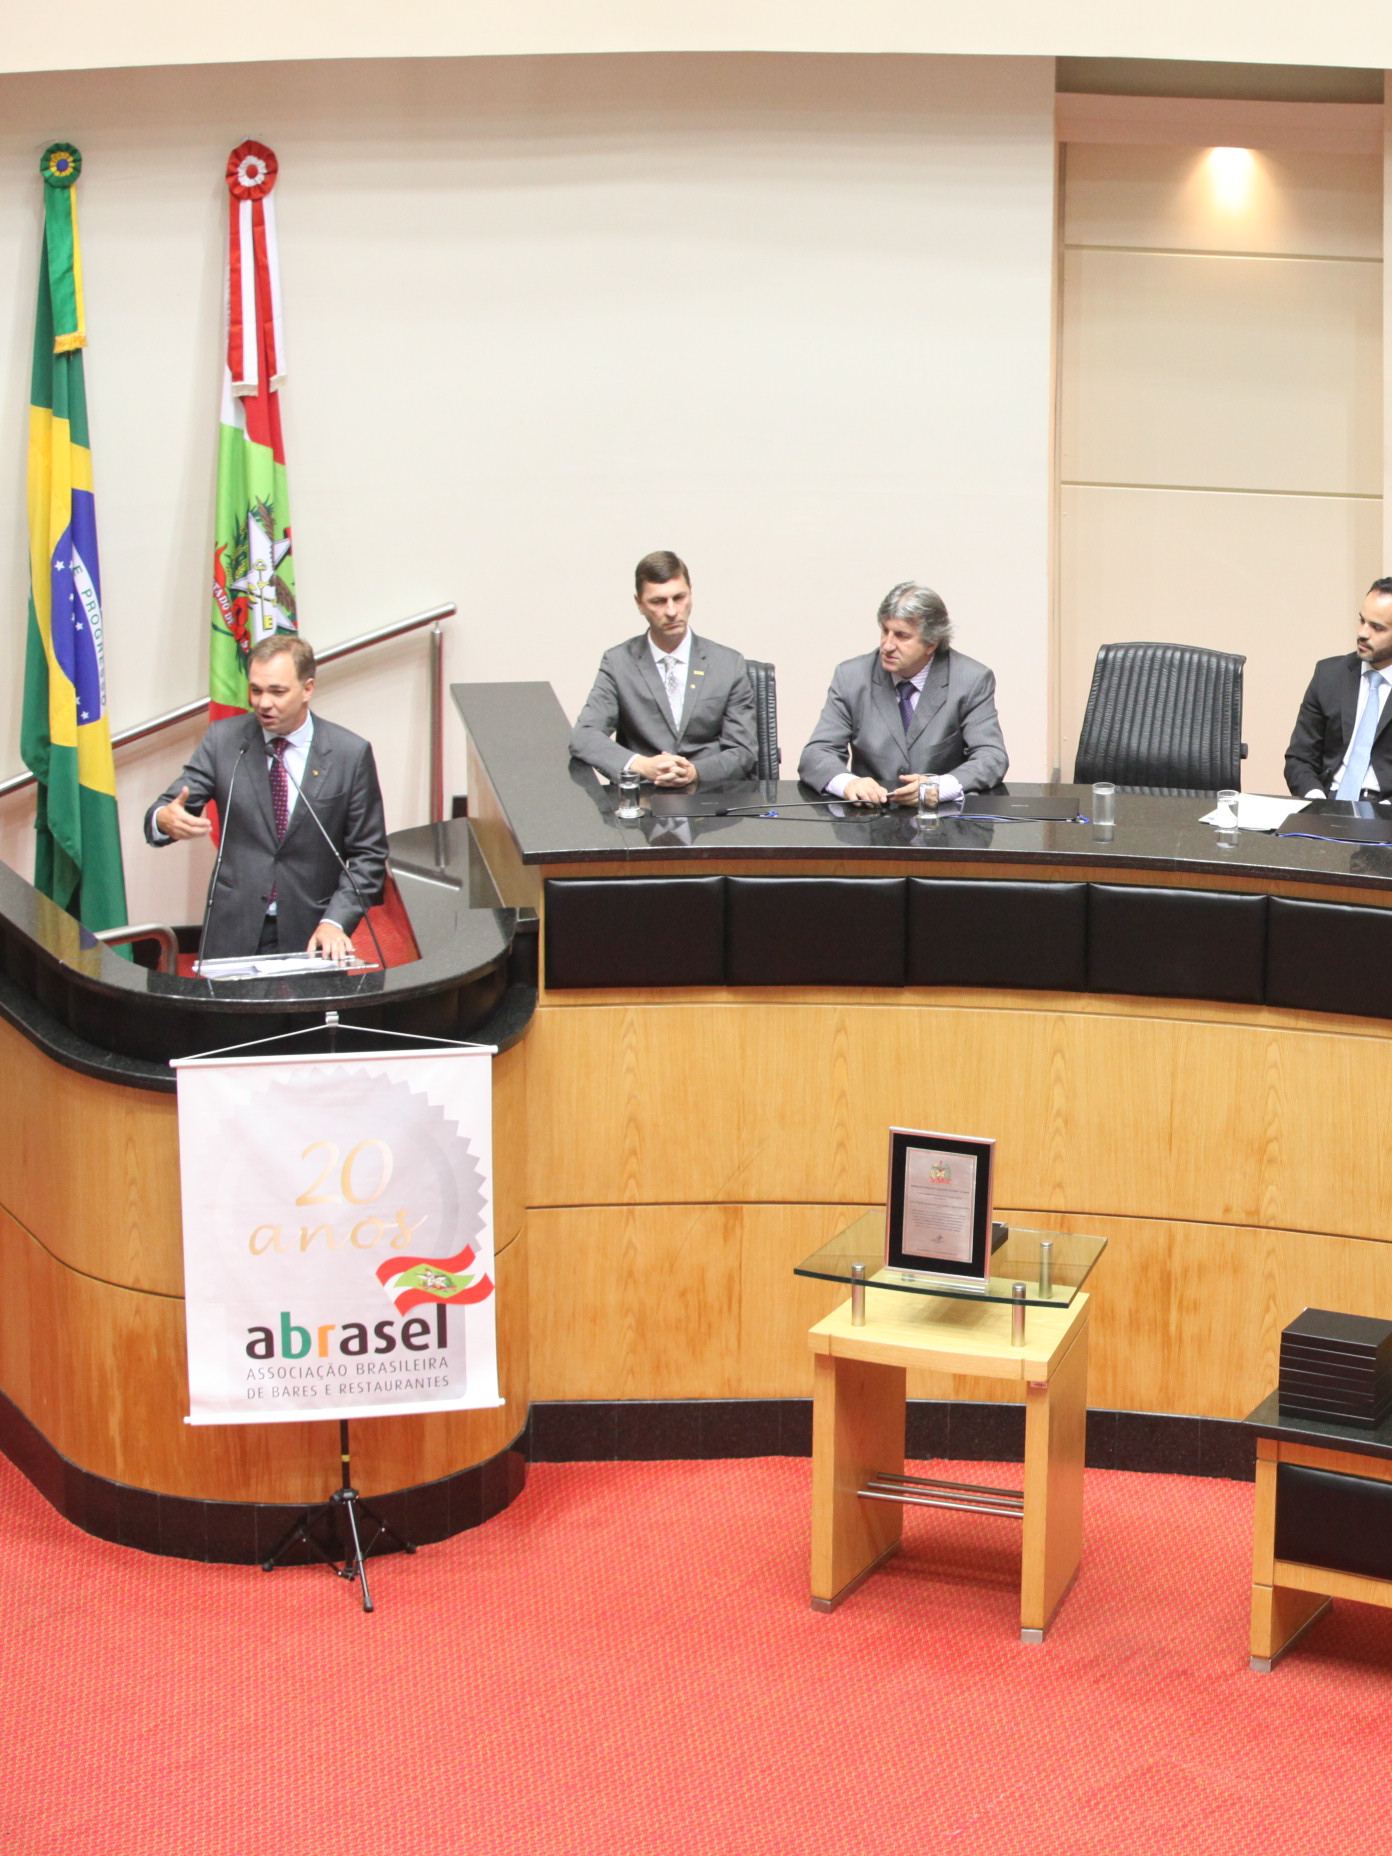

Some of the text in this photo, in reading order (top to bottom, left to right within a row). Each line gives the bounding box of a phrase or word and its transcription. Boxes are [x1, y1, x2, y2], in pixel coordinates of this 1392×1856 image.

[295, 1138, 394, 1207] 20
[248, 1208, 429, 1257] anos
[245, 1302, 448, 1360] abrasel
[246, 1356, 449, 1381] ASSOCIAÇÃO BRASILEIRA
[247, 1375, 450, 1400] DE BARES E RESTAURANTES
